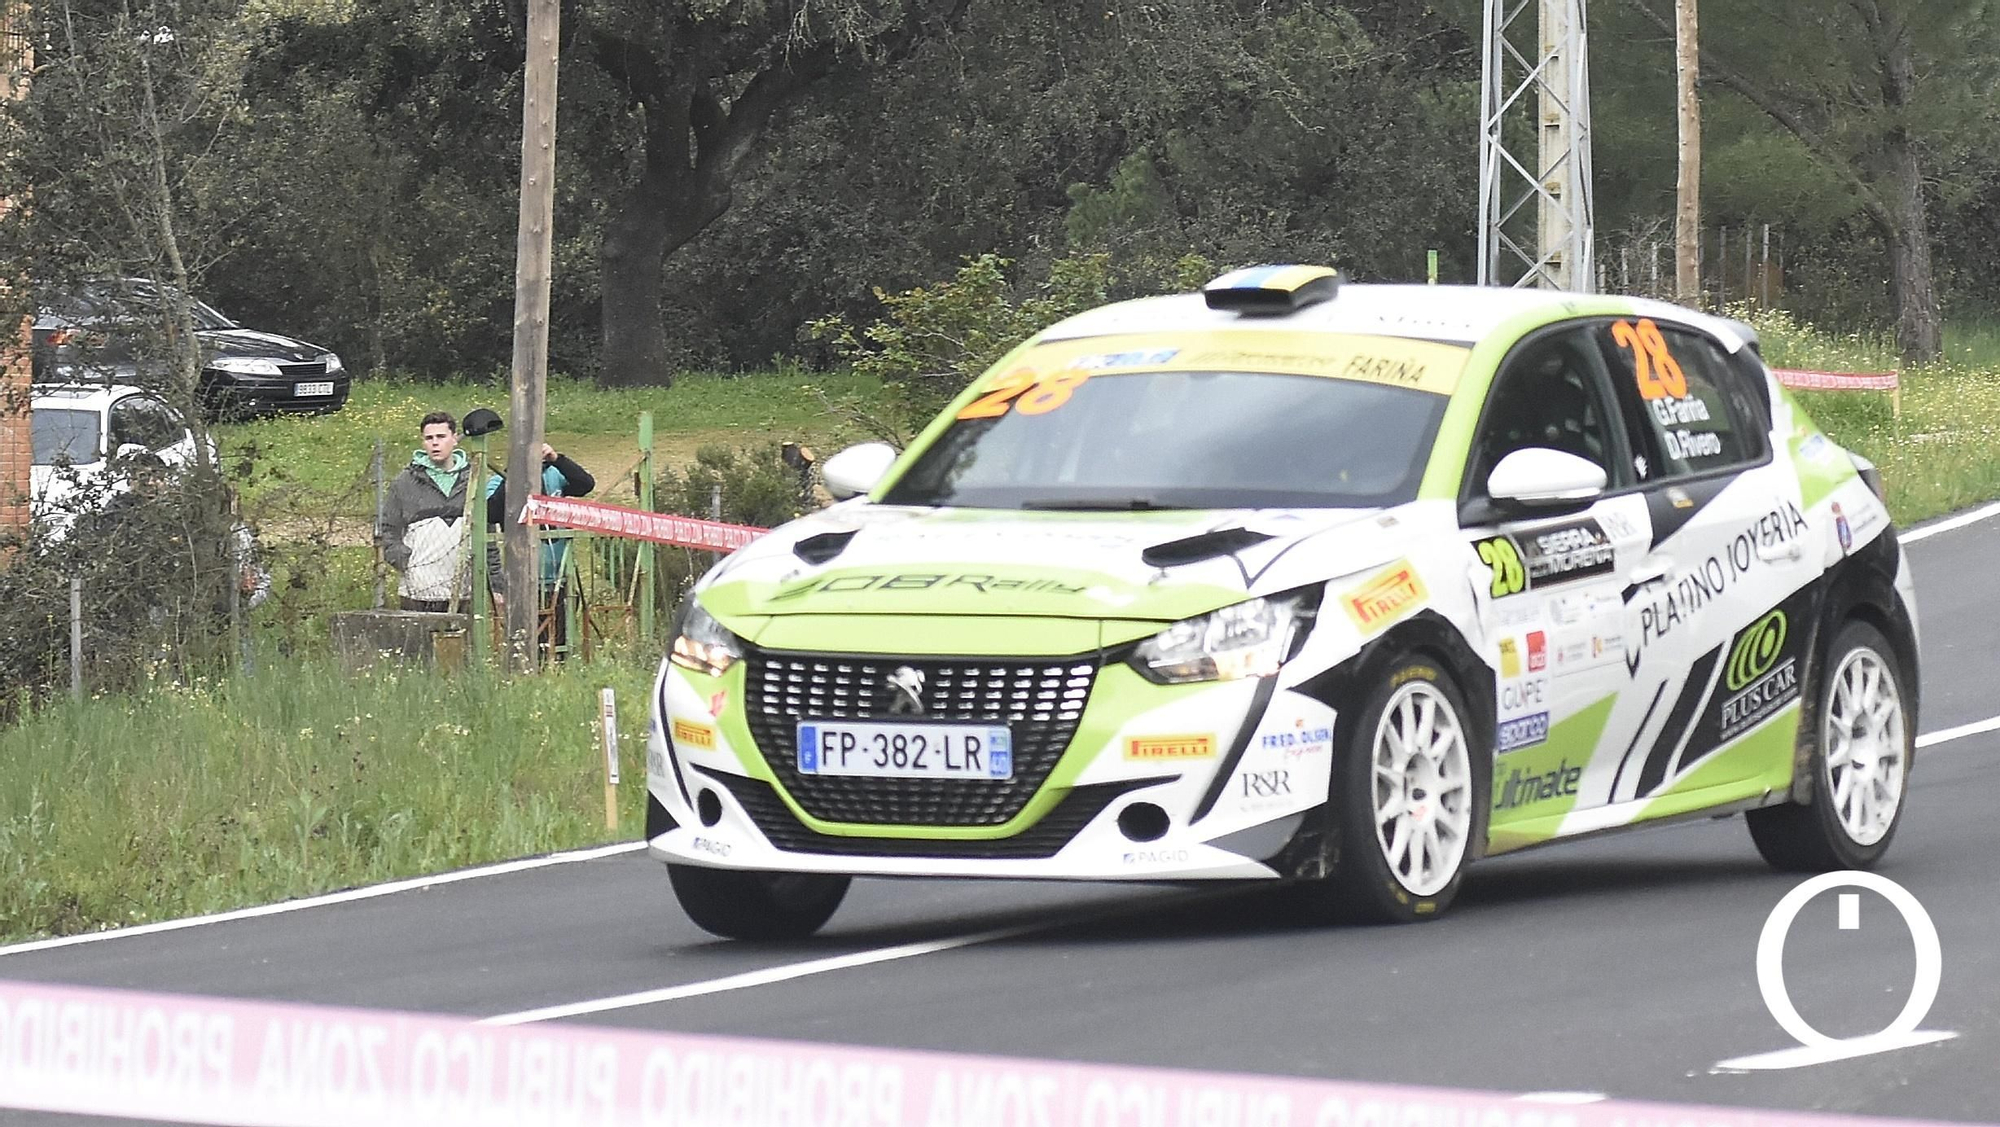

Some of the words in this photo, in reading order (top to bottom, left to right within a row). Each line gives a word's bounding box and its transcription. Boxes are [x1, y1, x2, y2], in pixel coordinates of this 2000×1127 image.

[1611, 318, 1687, 400] 28
[957, 367, 1090, 419] 28
[1478, 537, 1525, 599] 28
[1536, 527, 1596, 555] SIERRA
[1721, 687, 1762, 730] PLUS
[1763, 665, 1796, 701] CAR
[1131, 737, 1208, 756] PIRELLI
